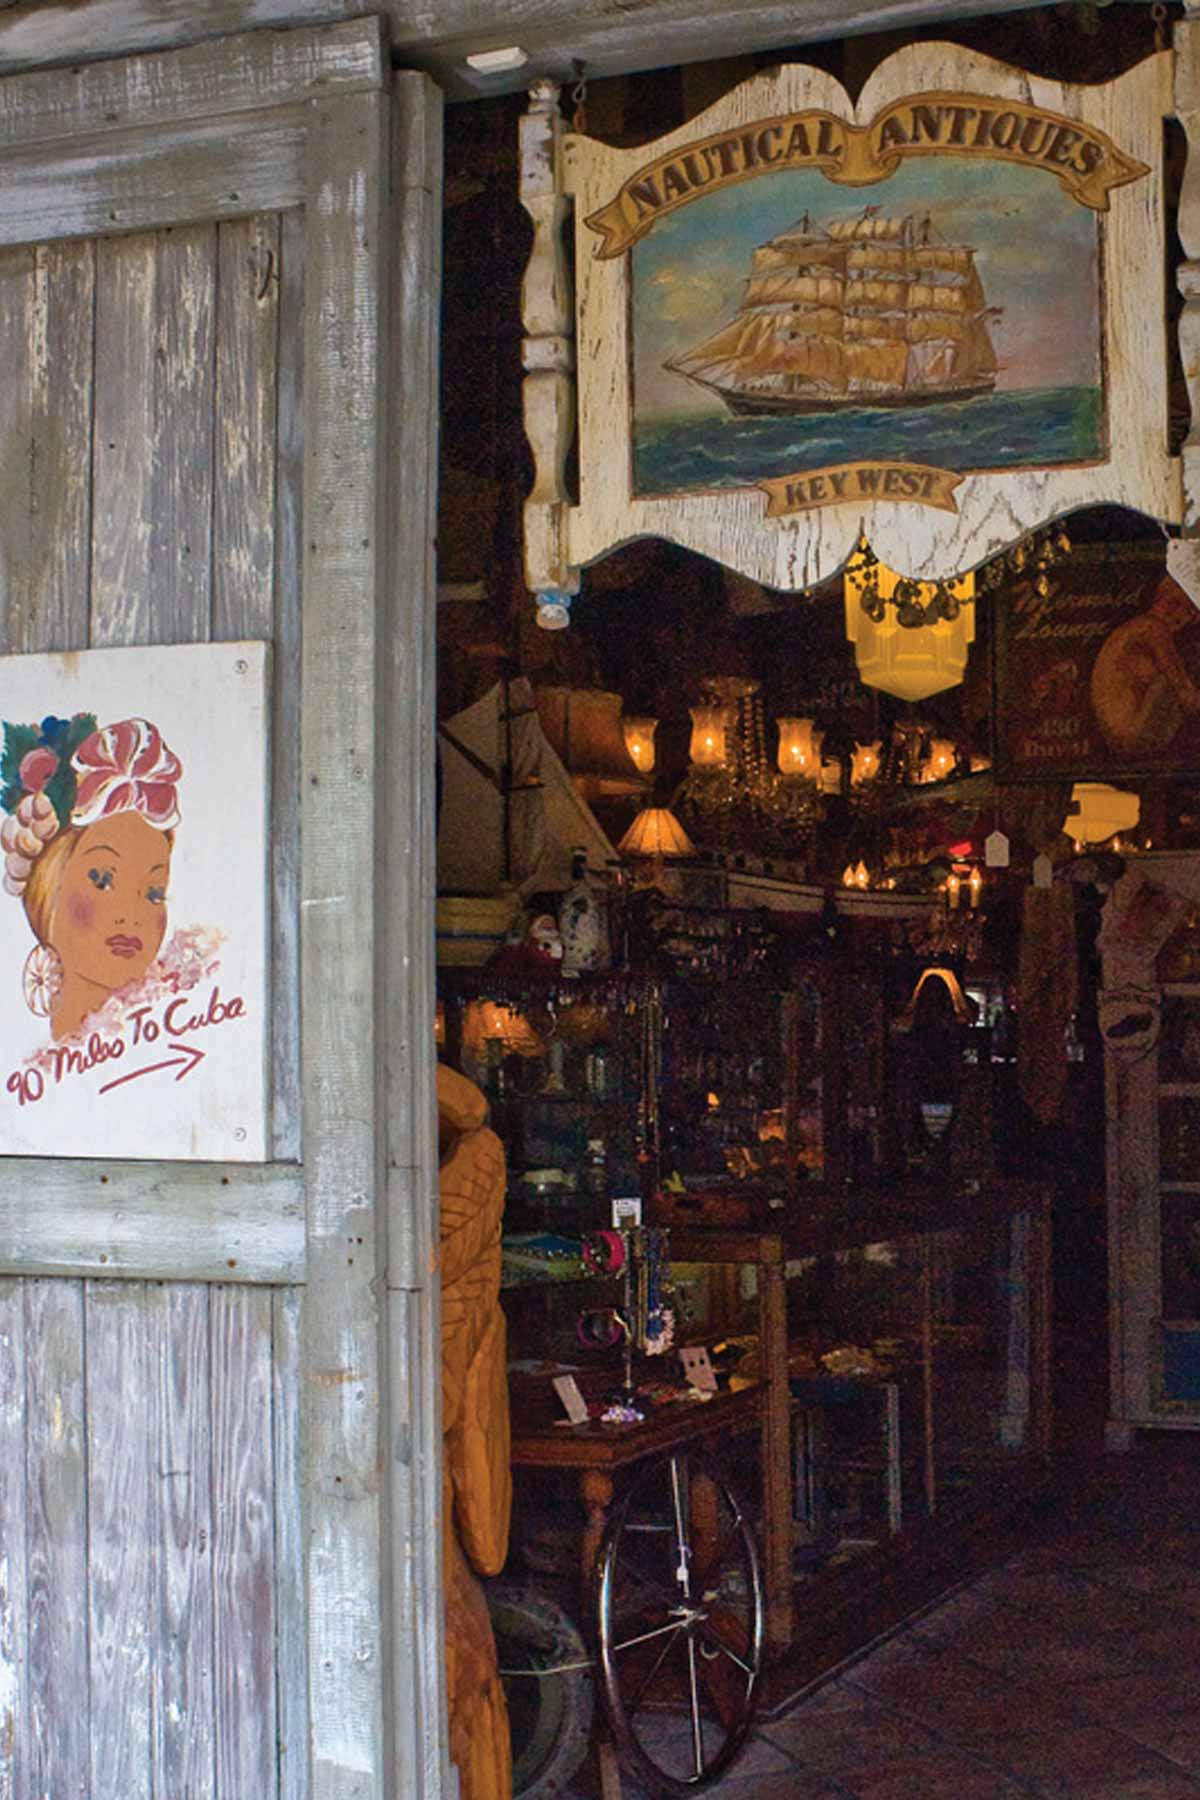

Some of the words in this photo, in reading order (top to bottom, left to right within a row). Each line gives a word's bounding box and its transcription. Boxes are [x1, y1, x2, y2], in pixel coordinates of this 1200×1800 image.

[631, 119, 843, 216] NAUTICAL
[876, 105, 1105, 180] ANTIQUES
[785, 475, 849, 500] KEY
[856, 470, 942, 499] WEST
[6, 1067, 45, 1106] 90
[47, 1032, 125, 1083] Miles
[127, 1006, 159, 1045] To
[163, 985, 246, 1036] Cuba
